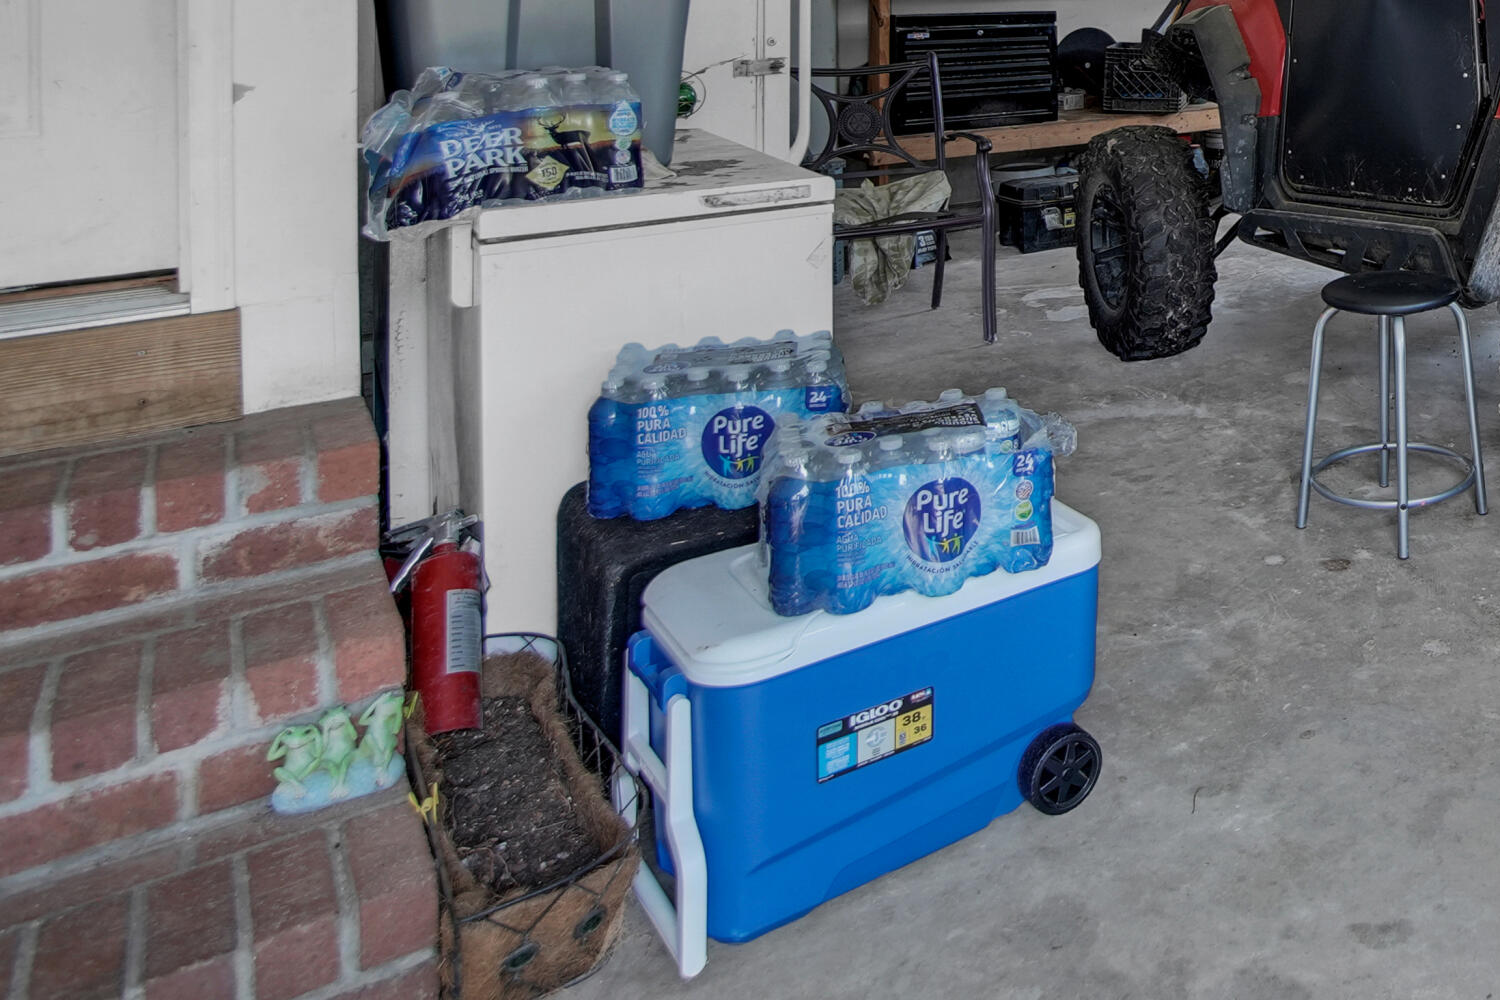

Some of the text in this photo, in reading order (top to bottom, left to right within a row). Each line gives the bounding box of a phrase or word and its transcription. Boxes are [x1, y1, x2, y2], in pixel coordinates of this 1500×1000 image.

[439, 127, 524, 160] DEER
[445, 146, 528, 179] PARK
[809, 391, 826, 403] 24
[636, 418, 671, 433] PURA
[713, 414, 765, 435] Pure
[636, 428, 688, 445] CALIDAD
[719, 433, 759, 458] Life
[1016, 453, 1034, 469] 24
[836, 495, 872, 514] PURA
[916, 487, 969, 511] Pure
[836, 506, 887, 529] CALIDAD
[923, 509, 964, 537] Life
[848, 699, 904, 728] IGLOO
[902, 711, 921, 727] 38
[913, 723, 928, 735] 36
